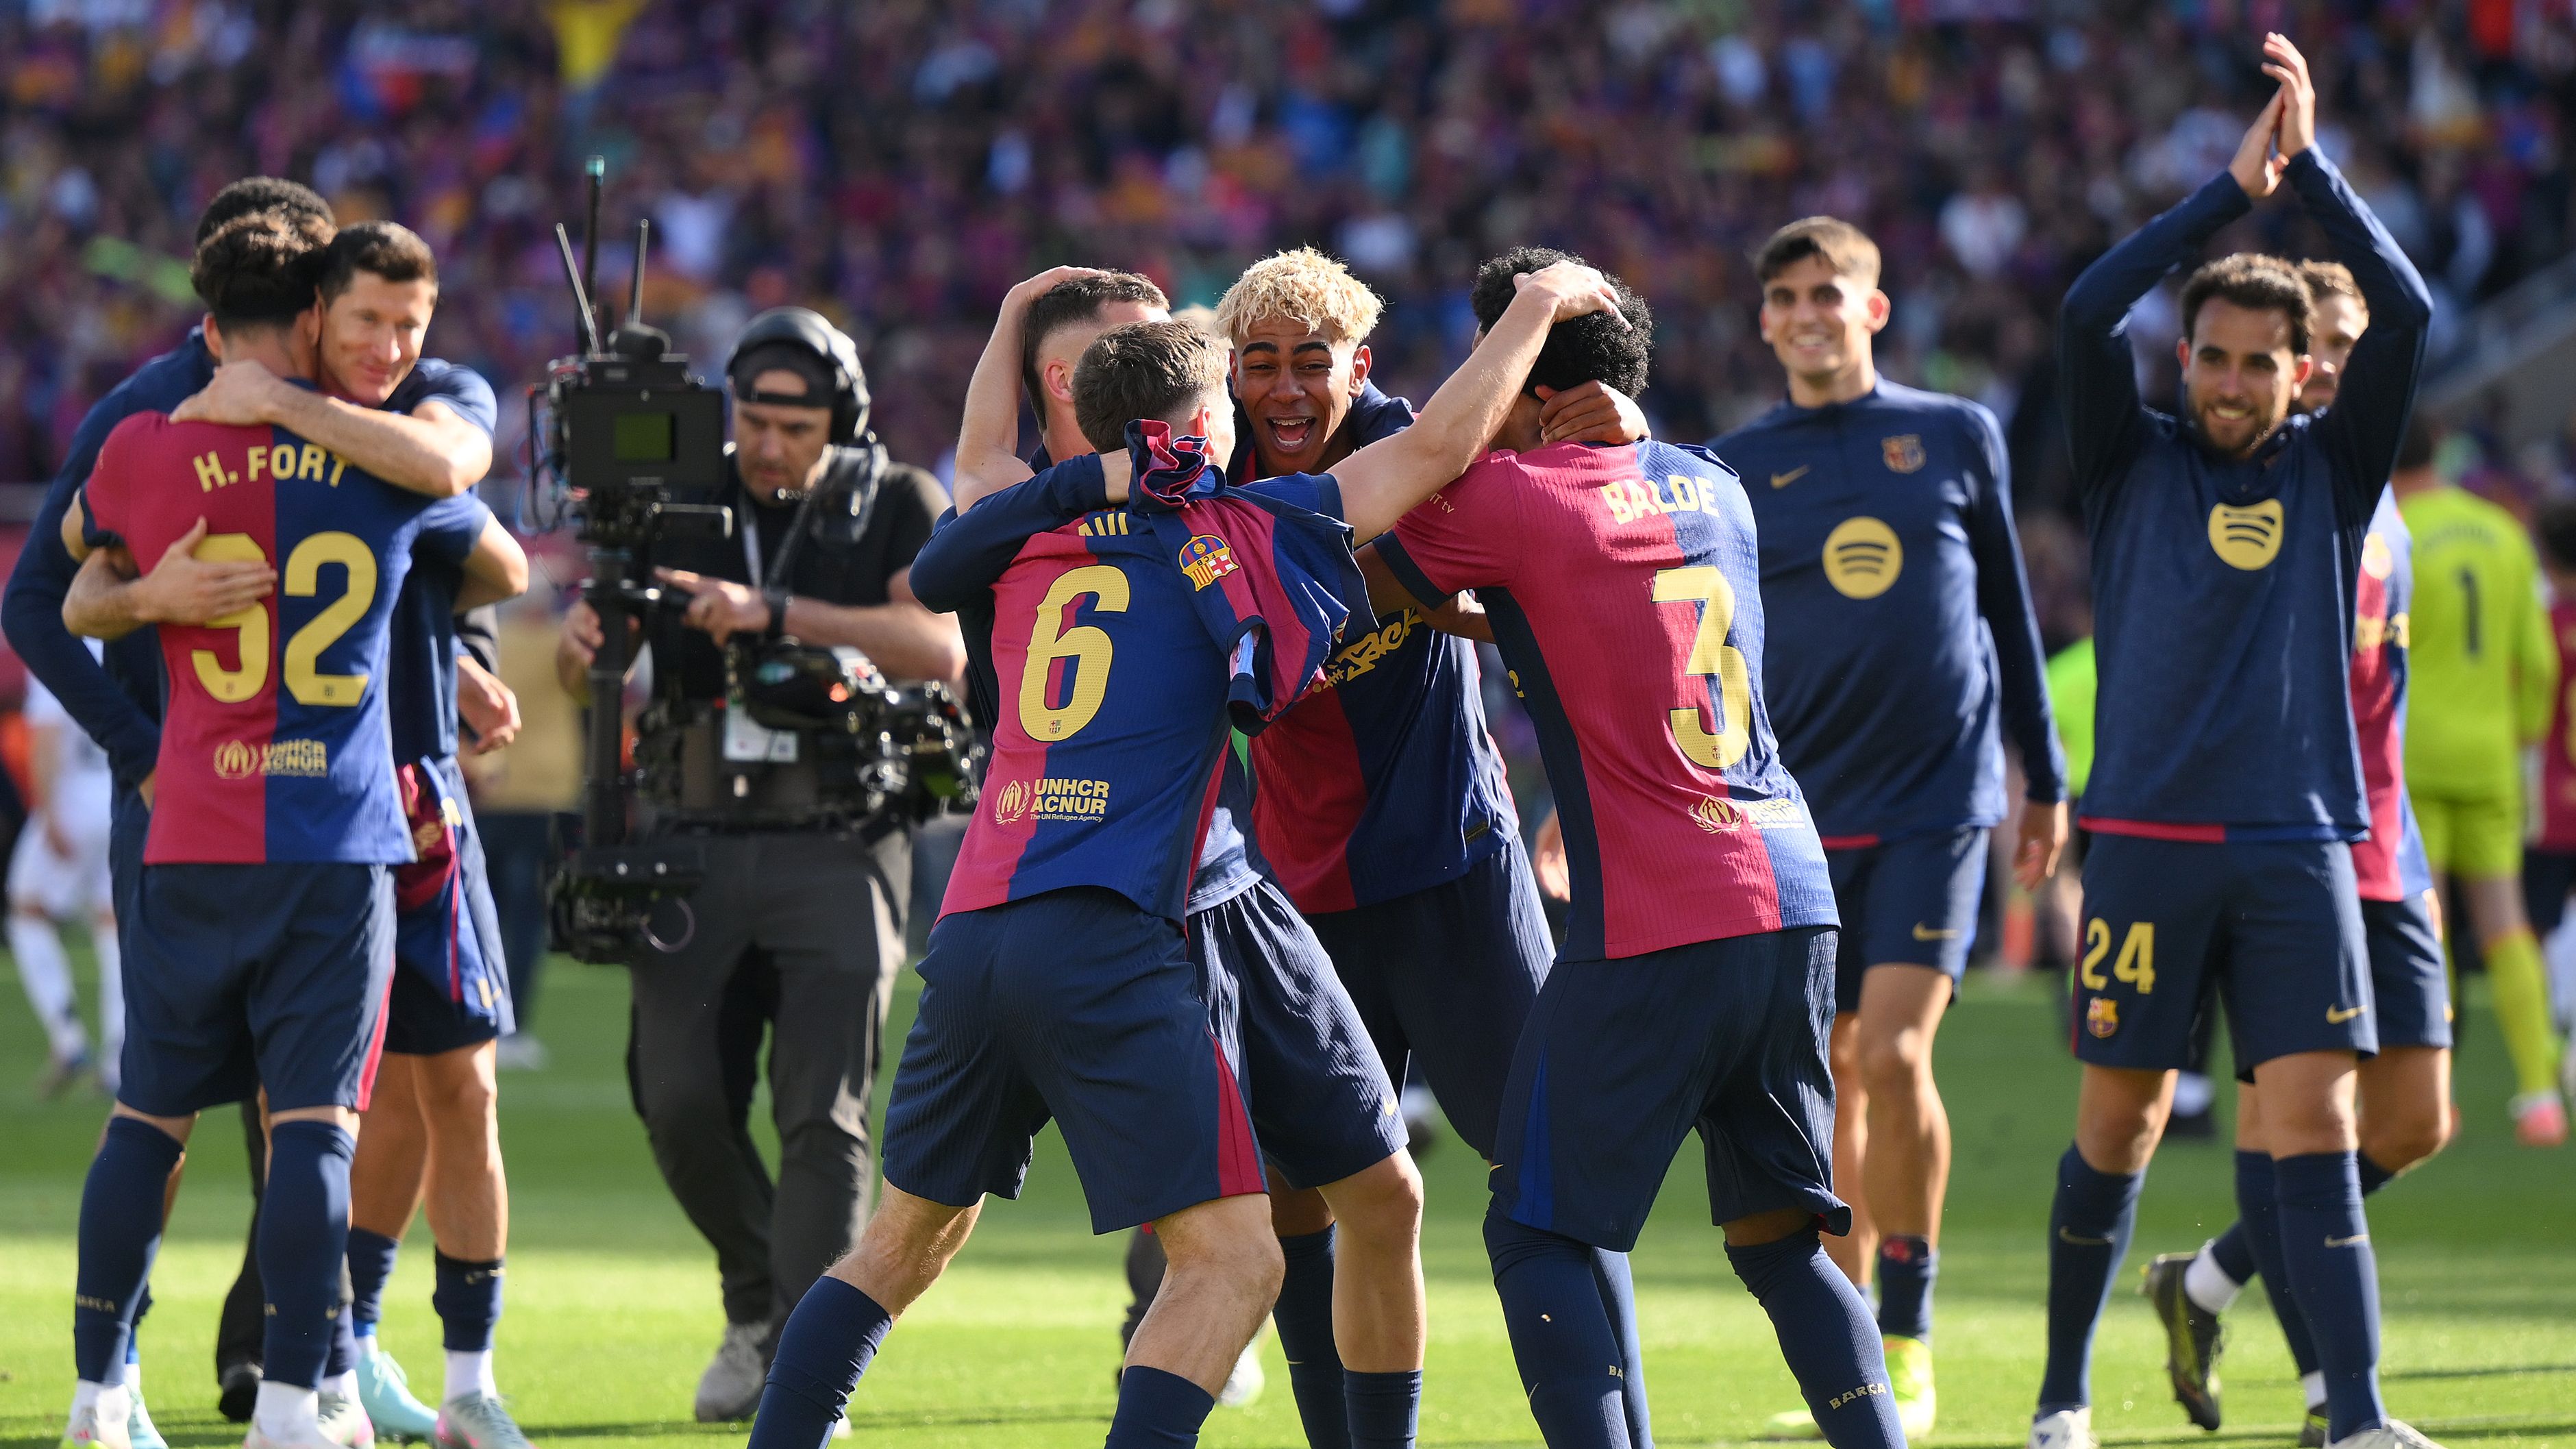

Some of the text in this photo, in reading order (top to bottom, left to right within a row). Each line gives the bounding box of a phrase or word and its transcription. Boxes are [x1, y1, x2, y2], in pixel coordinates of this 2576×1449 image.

[193, 443, 350, 493] H. FORT
[1441, 501, 1454, 513] tv
[1601, 474, 1720, 525] BALDE
[2457, 566, 2481, 658] 1
[1019, 565, 1130, 742] 6
[1651, 565, 1750, 769] 3
[1030, 796, 1106, 815] ACNUR
[1034, 778, 1110, 798] UNHCR
[2081, 917, 2156, 995] 24
